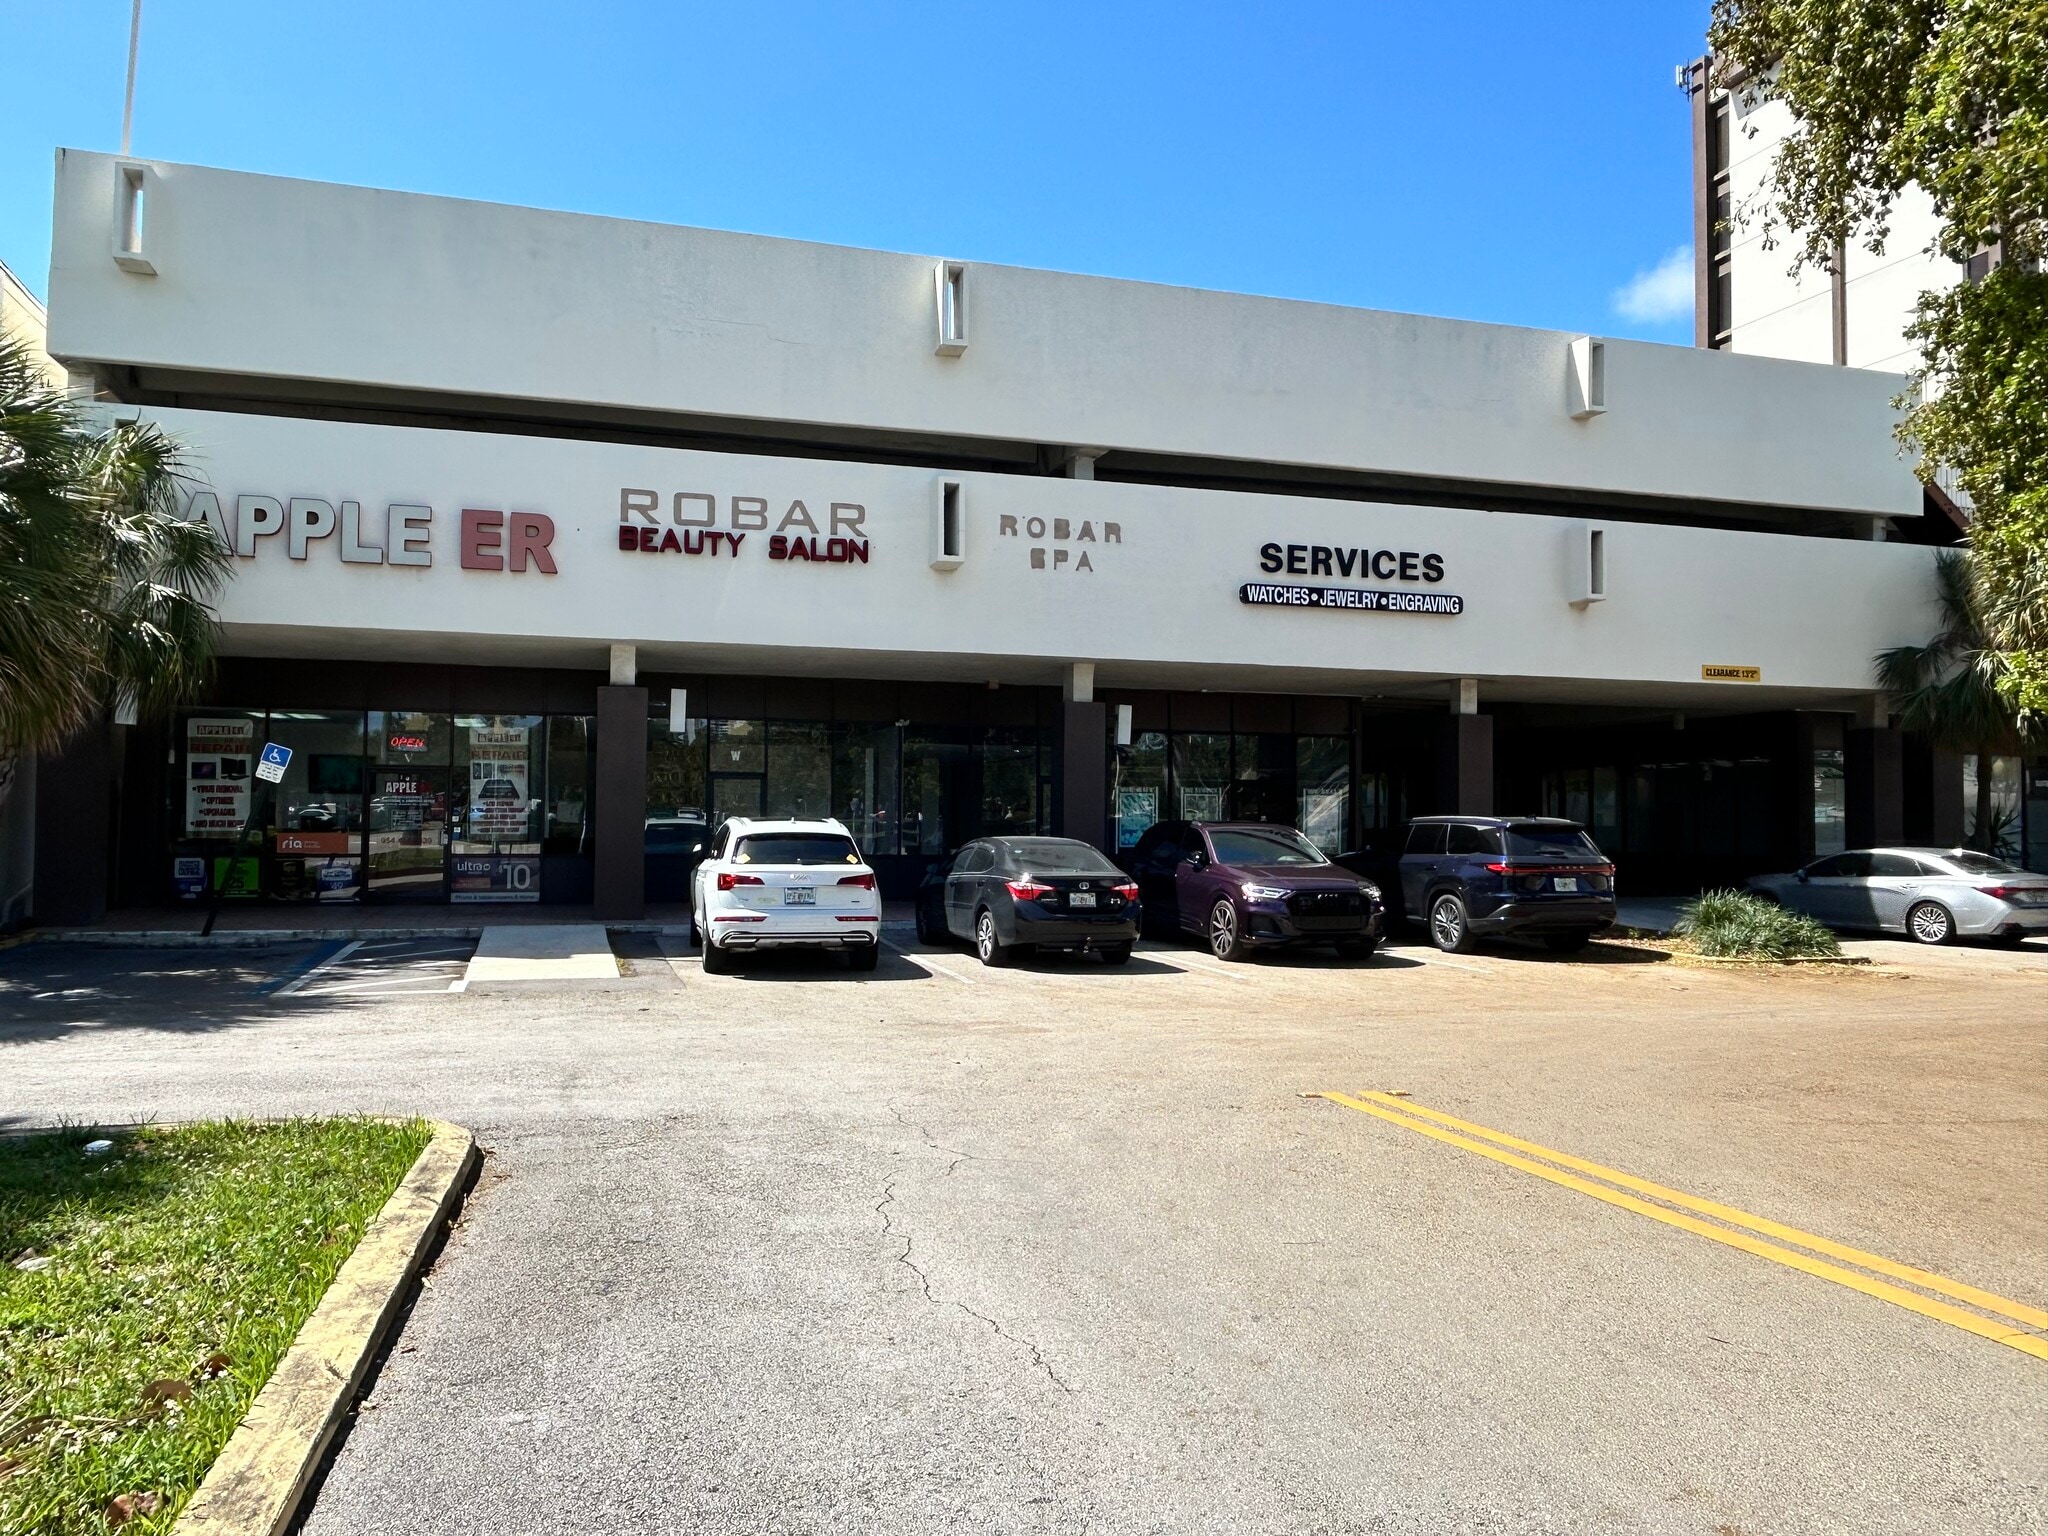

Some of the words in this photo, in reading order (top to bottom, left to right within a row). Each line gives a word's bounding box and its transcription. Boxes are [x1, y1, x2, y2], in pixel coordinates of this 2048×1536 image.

[620, 488, 867, 537] ROBAR
[184, 491, 433, 567] APPLE
[460, 508, 558, 574] ER
[999, 514, 1122, 544] ROBAR
[618, 525, 746, 558] BEAUTY
[768, 534, 869, 564] SALON
[1030, 547, 1093, 573] SPA
[1260, 542, 1445, 583] SERVICES
[390, 736, 426, 749] OPEN
[385, 781, 417, 793] APPLE
[282, 836, 303, 849] ria
